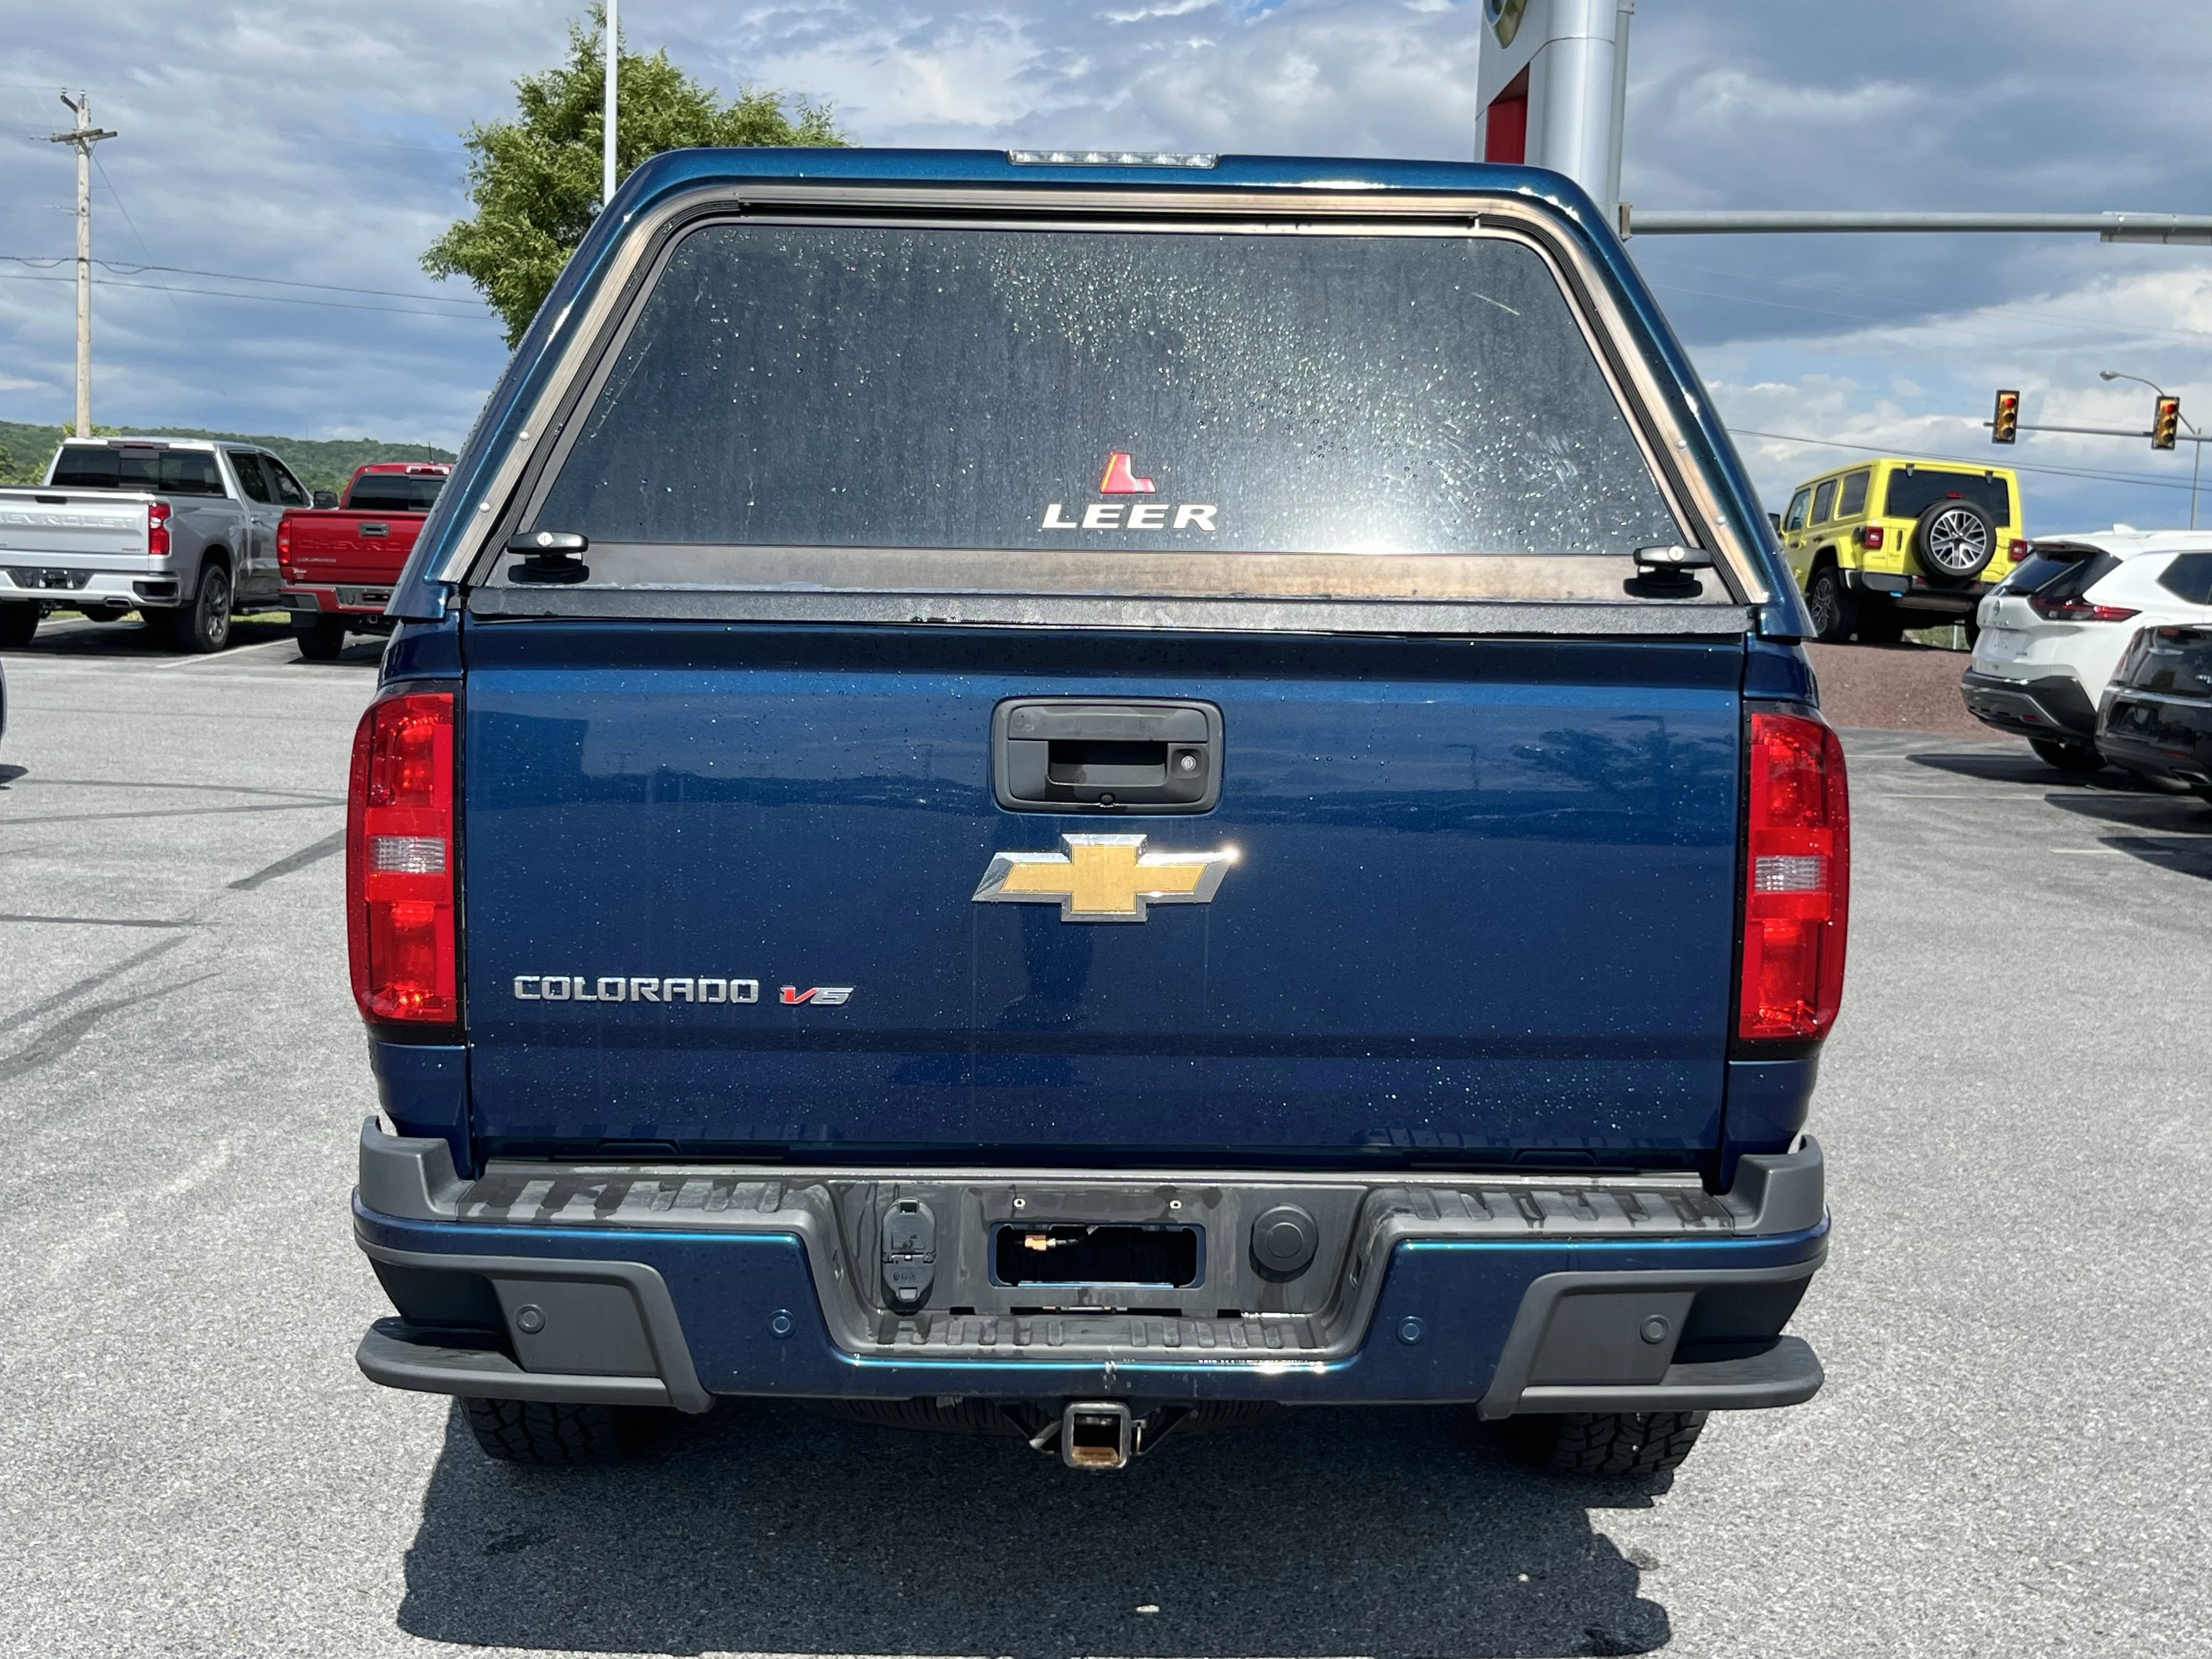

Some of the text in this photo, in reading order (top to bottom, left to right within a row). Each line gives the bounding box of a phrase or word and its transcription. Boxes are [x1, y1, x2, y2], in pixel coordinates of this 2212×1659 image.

[1042, 503, 1218, 532] LEER
[513, 975, 854, 1005] COLORADO V6
